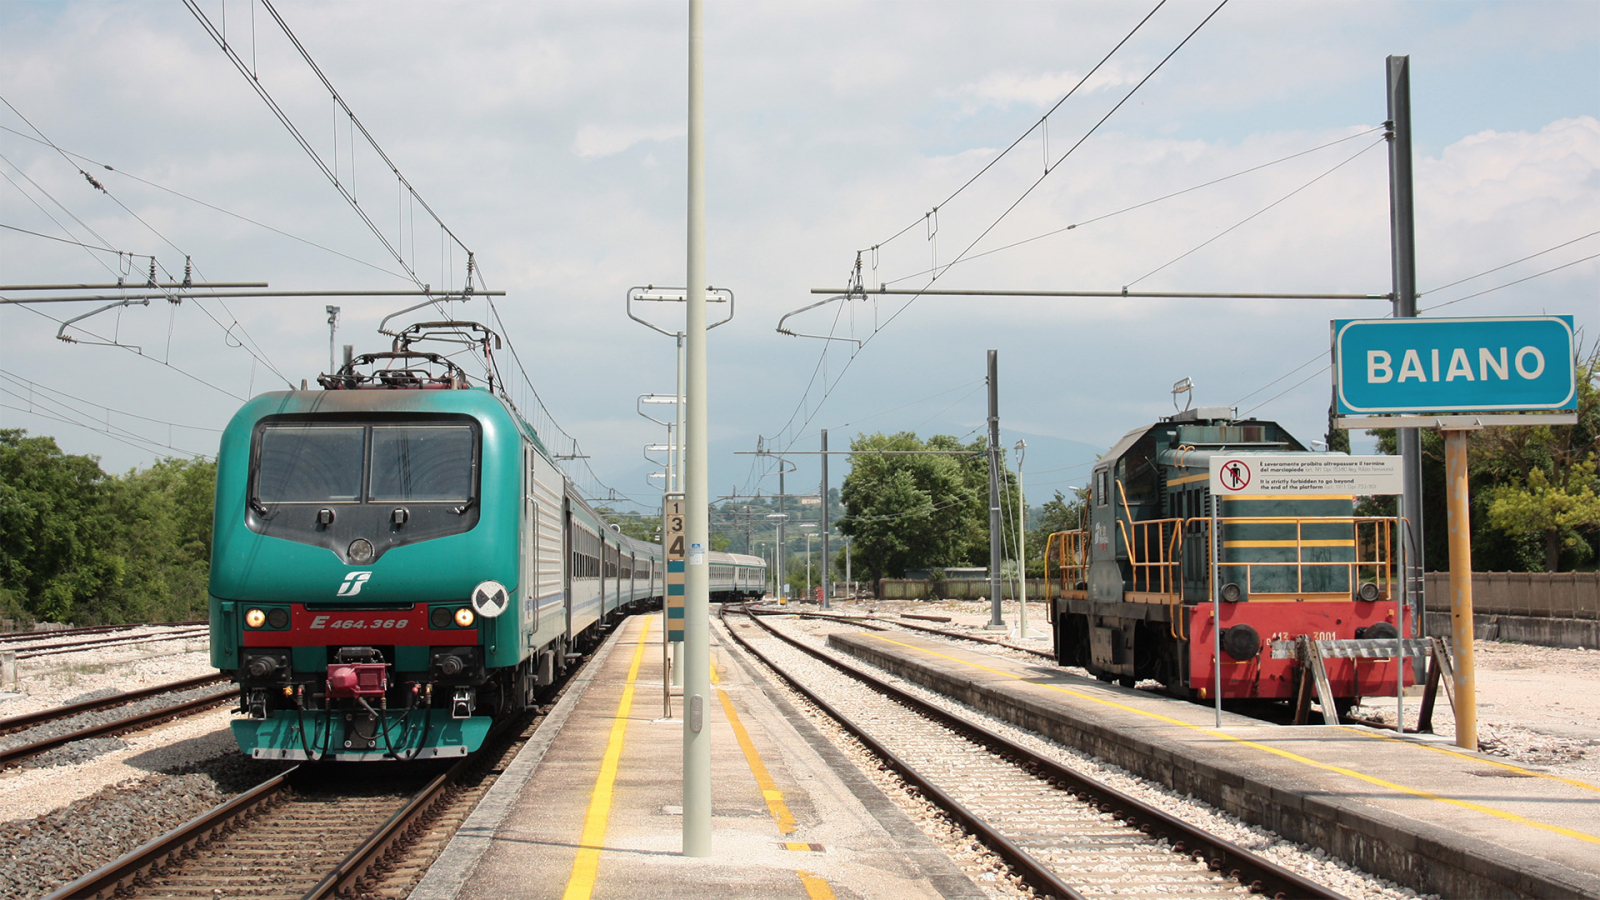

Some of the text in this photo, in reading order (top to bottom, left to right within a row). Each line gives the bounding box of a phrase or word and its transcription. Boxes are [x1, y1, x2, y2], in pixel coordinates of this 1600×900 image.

[1367, 345, 1545, 384] BAIANO
[673, 502, 679, 513] 1
[672, 517, 682, 531] 3
[669, 535, 685, 557] 4
[309, 616, 409, 629] E 464.368
[1313, 631, 1336, 641] 3001
